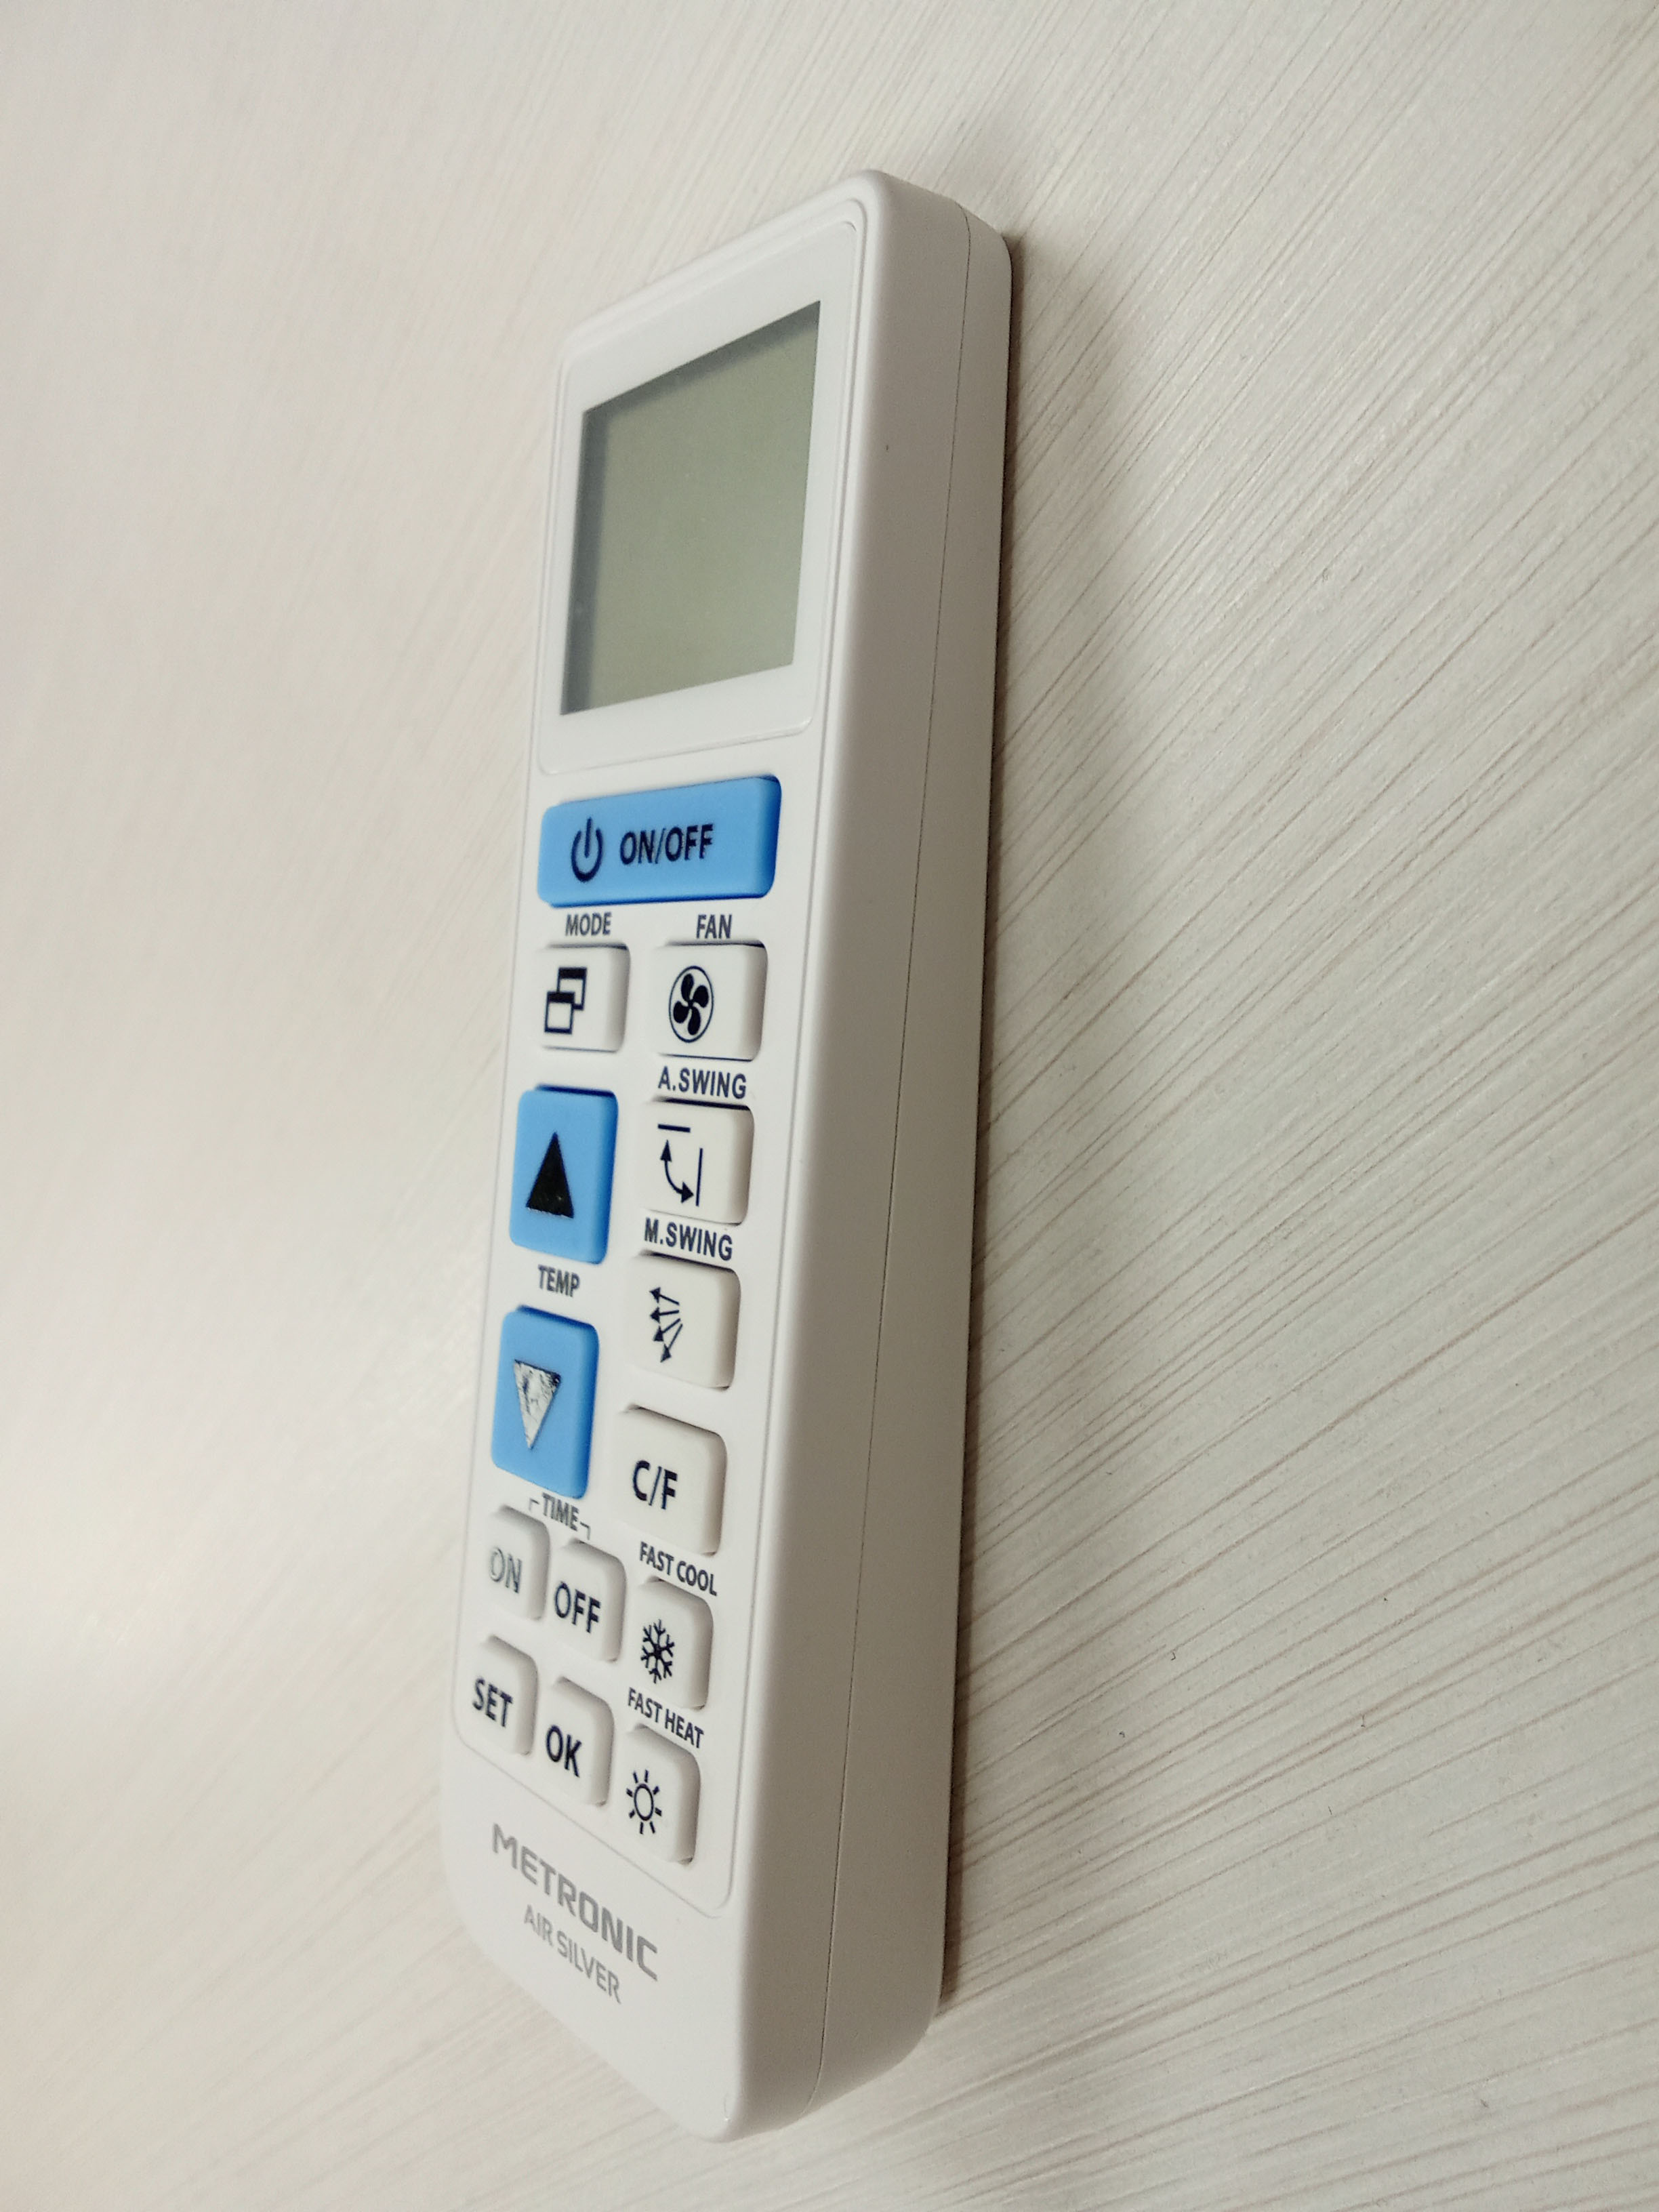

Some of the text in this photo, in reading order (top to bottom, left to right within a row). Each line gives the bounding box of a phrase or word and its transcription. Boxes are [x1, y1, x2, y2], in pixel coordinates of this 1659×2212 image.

[619, 823, 714, 865] ON/OFF
[565, 912, 611, 936] MODE
[696, 914, 732, 939] FAN
[657, 1065, 747, 1099] A.SWING
[644, 1218, 733, 1261] M.SWING
[538, 1264, 580, 1297] TEMP
[632, 1460, 678, 1510] C/F
[542, 1492, 579, 1531] TIME
[489, 1547, 523, 1593] ON
[639, 1541, 718, 1596] FAST COOL
[554, 1581, 600, 1633] OFF
[472, 1676, 513, 1728] SET
[628, 1687, 705, 1748] FAST HEAT
[546, 1724, 582, 1778] OK
[491, 1823, 658, 1982] METRONIC
[524, 1904, 621, 2004] AIR SILVER
